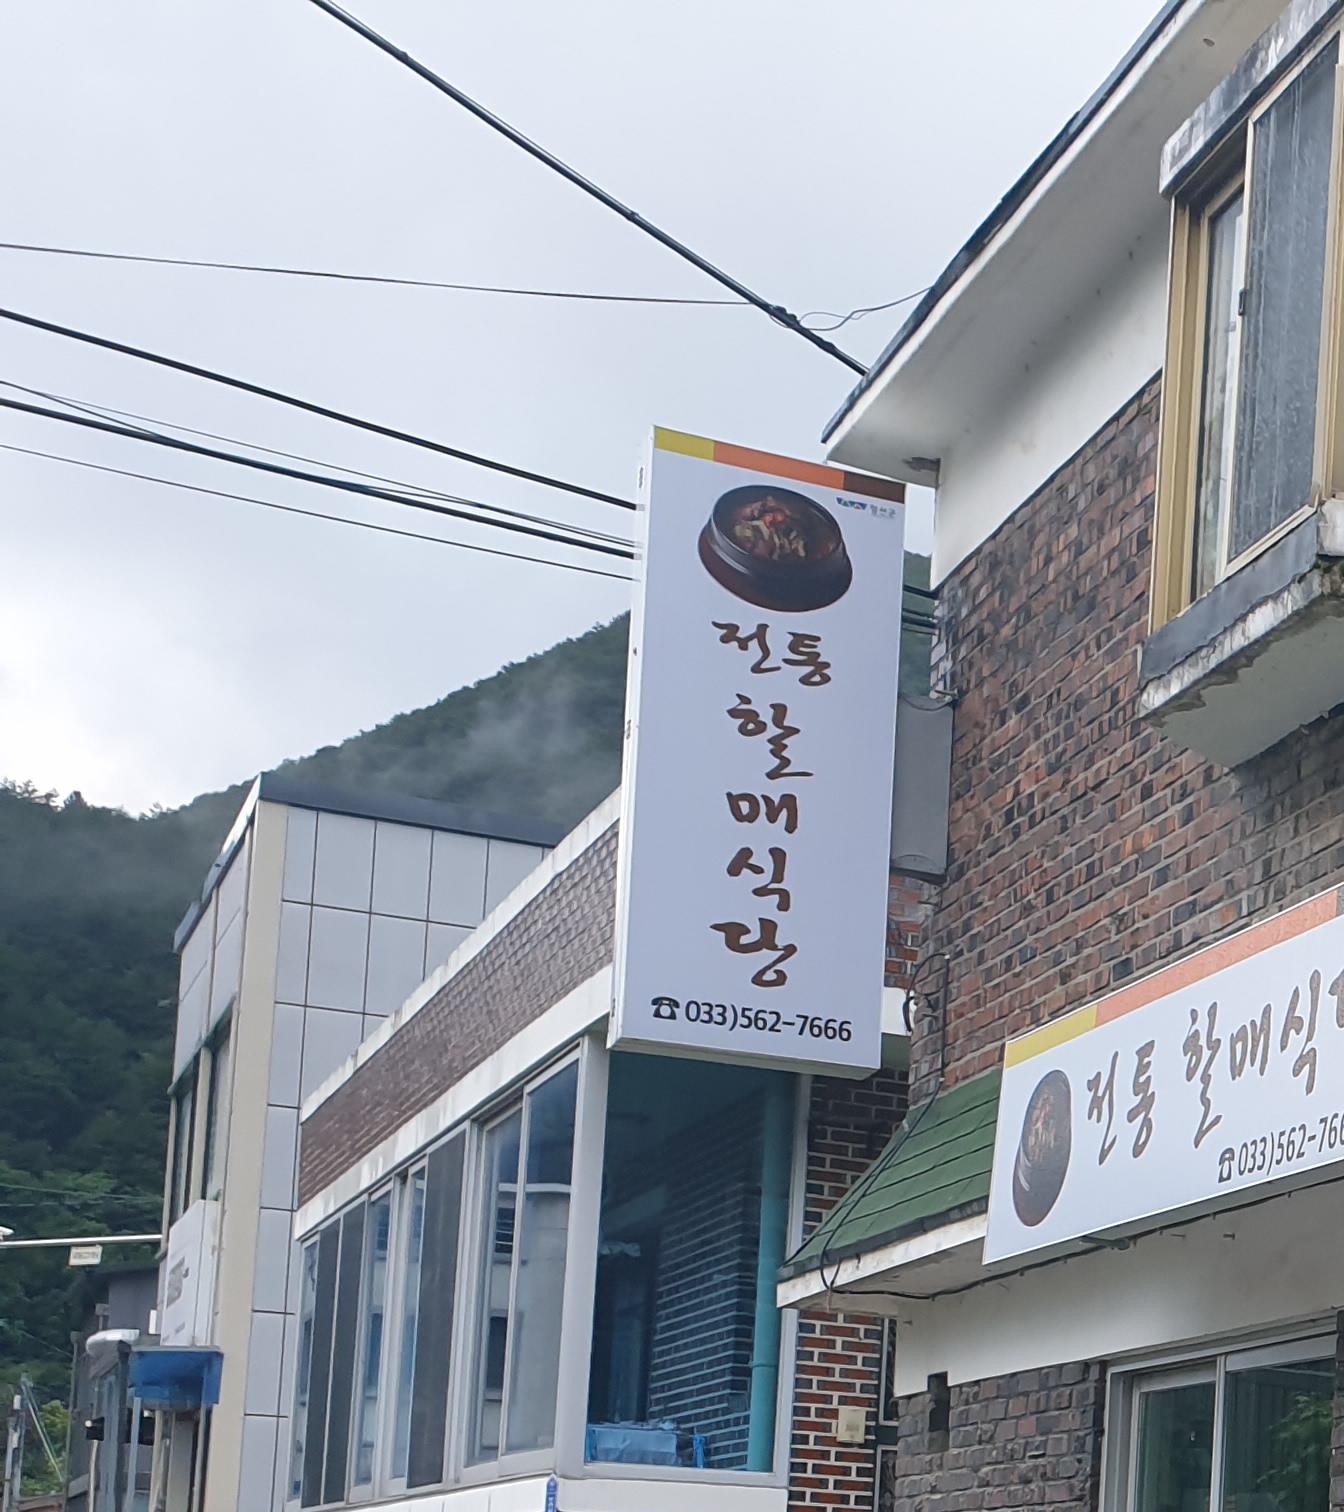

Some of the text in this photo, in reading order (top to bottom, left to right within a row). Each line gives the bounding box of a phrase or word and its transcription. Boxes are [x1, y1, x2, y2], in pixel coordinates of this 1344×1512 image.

[711, 620, 832, 687] 전통
[710, 694, 814, 988] 할매식당
[685, 1000, 853, 1043] 033)562-7666
[1086, 1039, 1156, 1166] 전통
